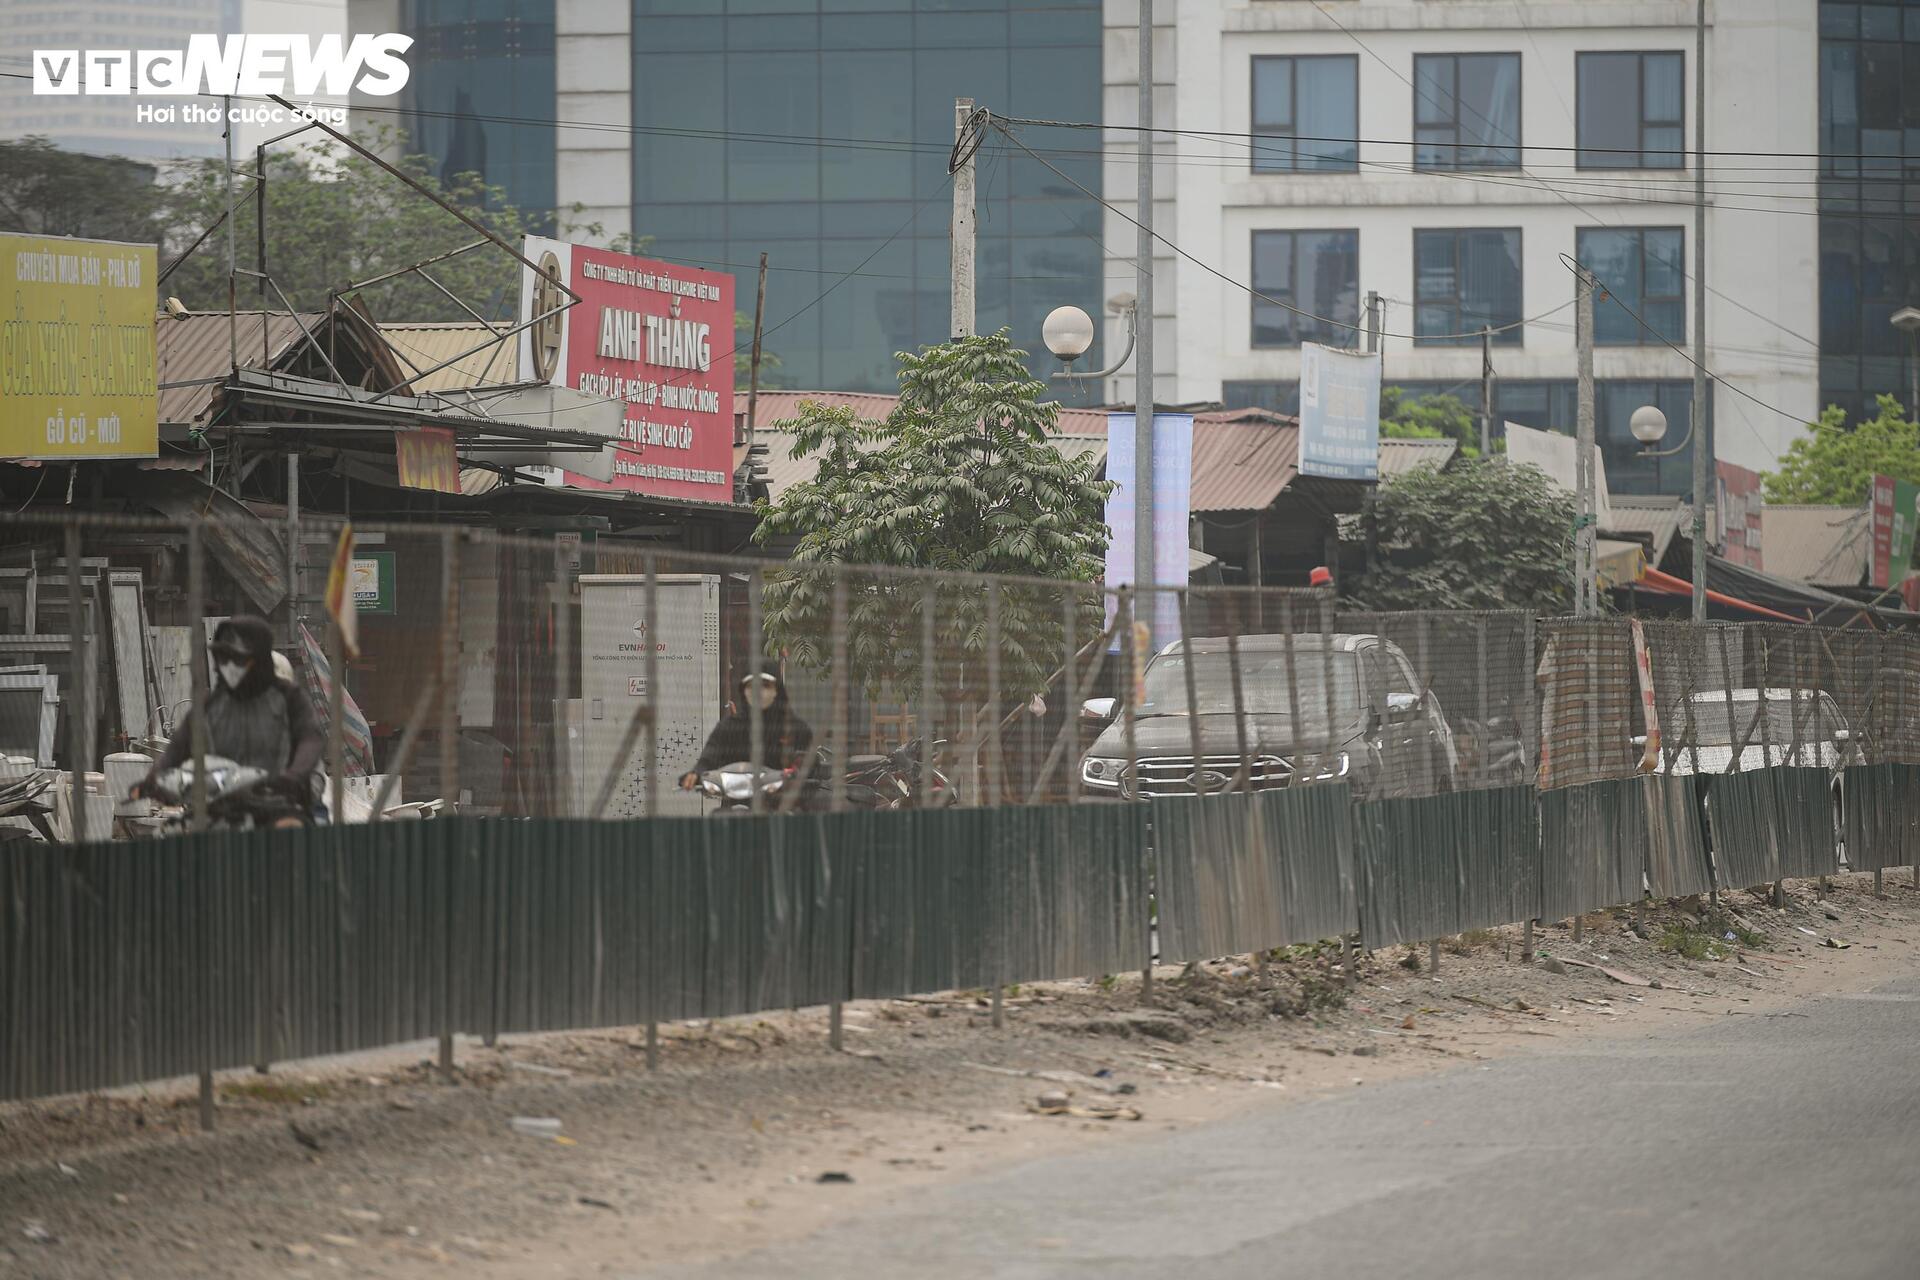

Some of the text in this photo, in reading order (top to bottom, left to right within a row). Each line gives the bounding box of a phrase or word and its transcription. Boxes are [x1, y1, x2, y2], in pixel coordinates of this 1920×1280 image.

[17, 247, 56, 283] CHUYÊN
[58, 254, 80, 285] MUA
[81, 250, 100, 286] BÁN
[584, 258, 597, 279] CÔNG
[597, 264, 604, 281] TY
[697, 279, 708, 303] VIỆT
[708, 285, 720, 302] NAM
[2, 290, 34, 396] CỬA
[37, 300, 80, 396] NHÔM
[89, 294, 117, 397] CỬA
[118, 313, 155, 417] NHỰA
[599, 295, 711, 373] ANH THẮNG
[610, 372, 624, 399] LÁT
[626, 374, 644, 403] NGÓI
[644, 380, 658, 411] LỢP
[661, 379, 679, 408] BÌNH
[679, 381, 698, 411] NƯỚC
[698, 383, 719, 414] NÓNG
[47, 408, 65, 444] GỖ
[70, 412, 86, 444] CŨ
[97, 412, 120, 443] MỚI
[647, 421, 663, 446] SINH
[663, 424, 678, 448] CAO
[678, 419, 693, 450] CẤP
